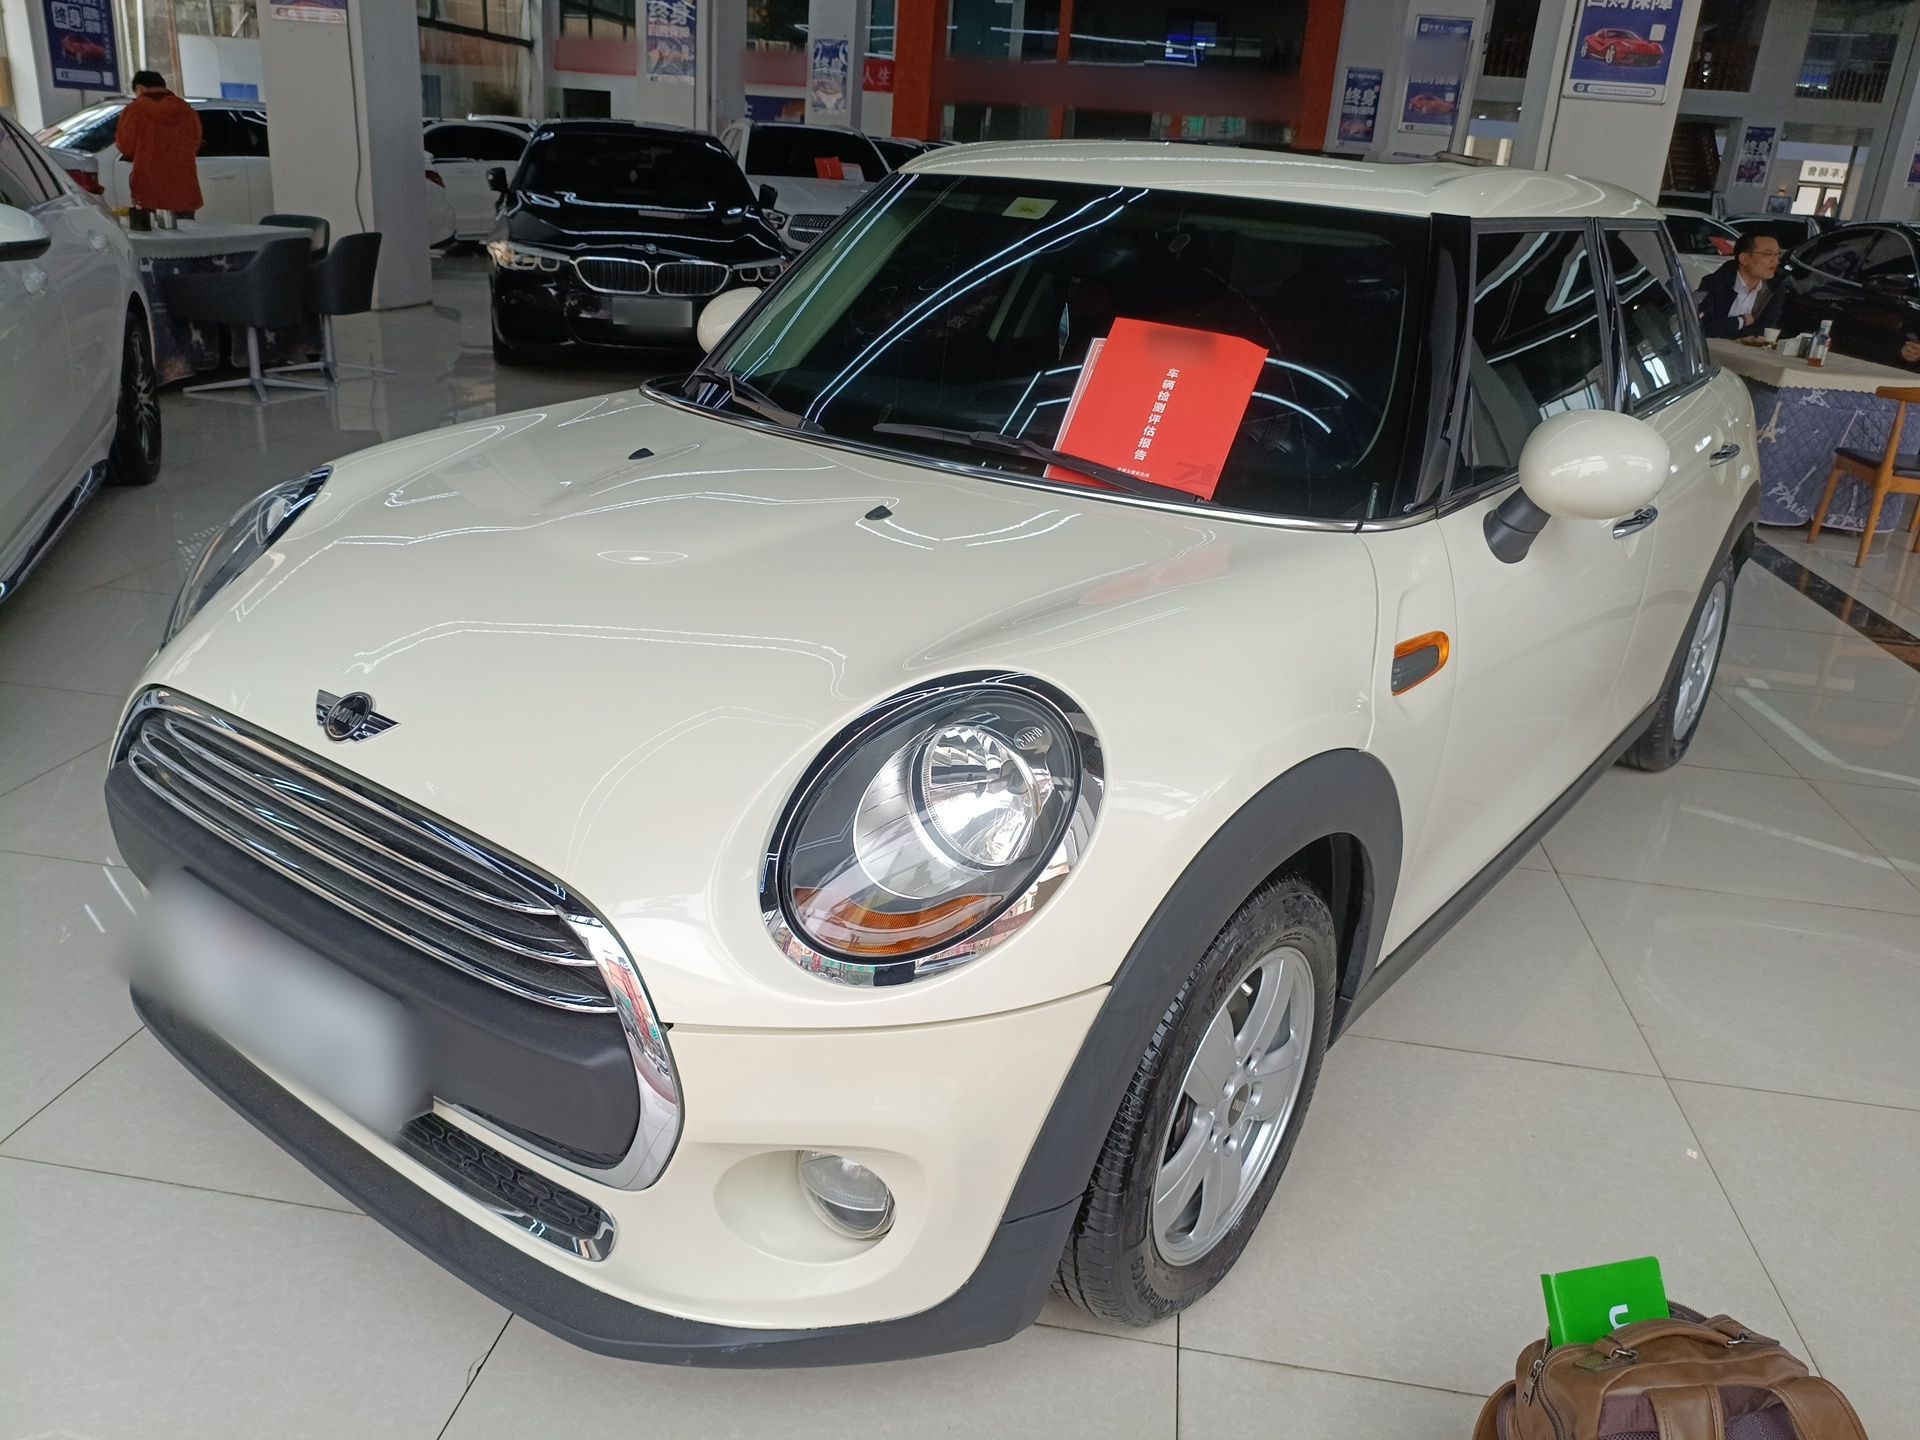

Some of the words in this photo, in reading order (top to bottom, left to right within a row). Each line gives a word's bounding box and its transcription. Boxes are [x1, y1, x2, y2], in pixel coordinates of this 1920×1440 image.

[864, 65, 892, 86] 人生
[1344, 87, 1377, 106] 终身
[1133, 368, 1180, 461] 车辆检测评估报告
[331, 704, 363, 728] MINI
[1016, 727, 1043, 748] MINI
